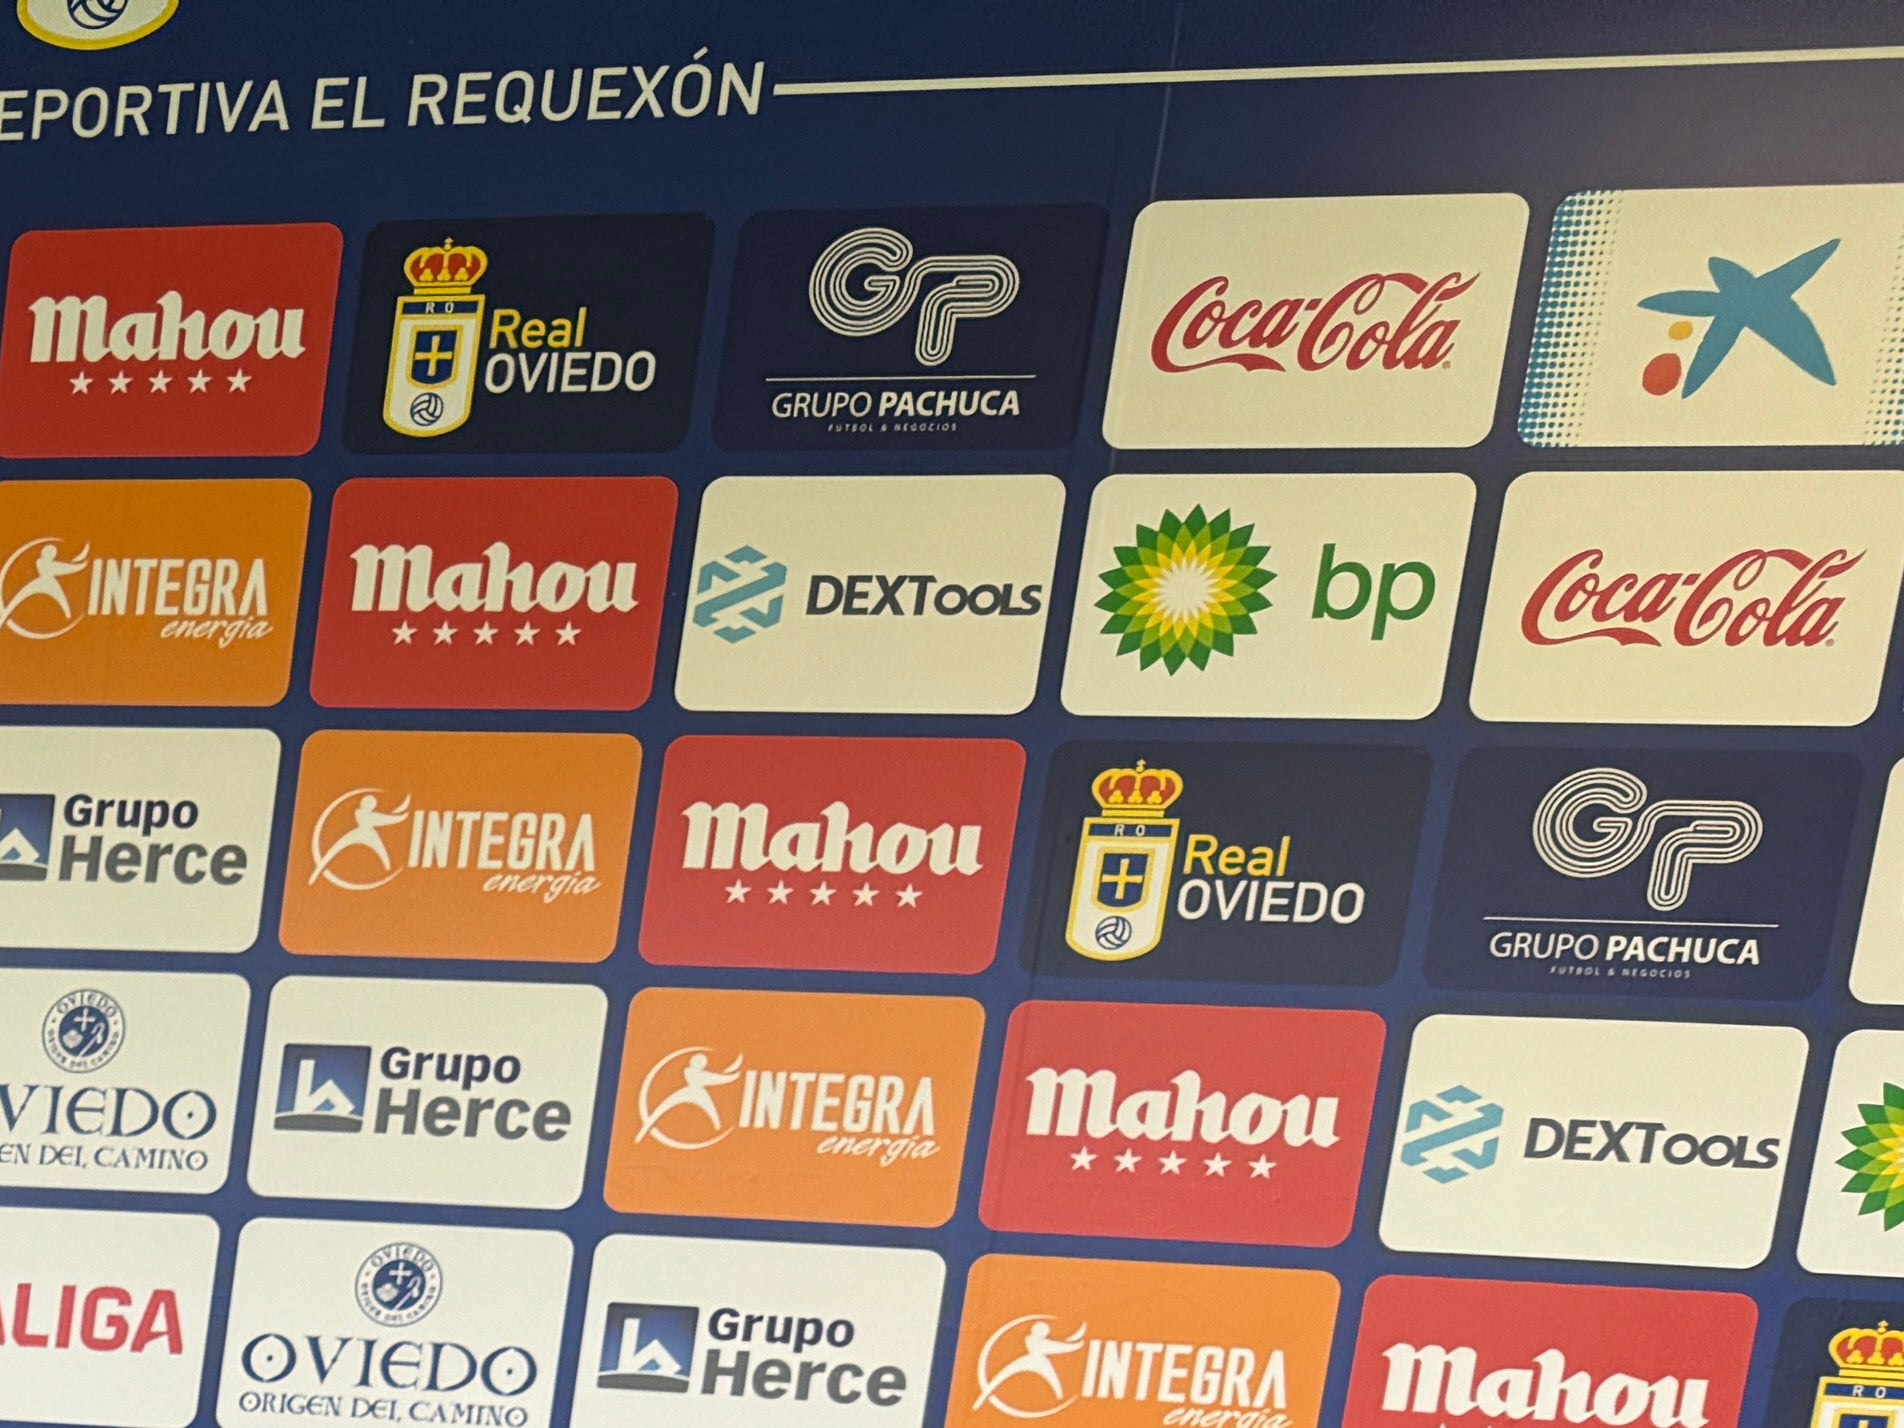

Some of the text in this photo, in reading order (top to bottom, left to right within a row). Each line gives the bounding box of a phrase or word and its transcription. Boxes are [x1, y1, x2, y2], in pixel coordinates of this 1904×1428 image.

[310, 78, 385, 128] EL
[409, 49, 766, 127] REQUEXÓN
[29, 291, 305, 362] Mahou
[490, 309, 587, 349] Real
[1150, 272, 1481, 374] Coca-Cola
[484, 351, 656, 394] OVIEDO
[771, 389, 1021, 419] GRUPO PACHUCA
[88, 555, 268, 615] INTEGRA
[350, 541, 639, 615] Mahou
[1312, 542, 1436, 641] bp
[1520, 548, 1868, 648] Coca-Cola
[63, 794, 199, 833] Grupo
[408, 808, 595, 870] INTEGRA
[682, 800, 983, 878] Mahou
[59, 833, 247, 885] Herce
[1183, 835, 1289, 877] Real
[1176, 880, 1366, 924] OVIEDO
[1490, 931, 1761, 966] GRUPO PACHUCA
[380, 1047, 520, 1086] Grupo
[375, 1085, 571, 1139] Herce
[739, 1070, 935, 1136] INTEGRA
[1026, 1068, 1341, 1148] Mahou
[42, 1145, 86, 1168] DEL
[93, 1145, 208, 1171] CAMINO
[707, 1307, 855, 1349] Grupo
[241, 1333, 538, 1396] OVIEDO
[701, 1348, 907, 1407] Herce
[1084, 1337, 1286, 1409] INTEGRA
[1382, 1342, 1711, 1428] Mahou
[237, 1391, 529, 1427] ORIGEN DEL CAMINO
